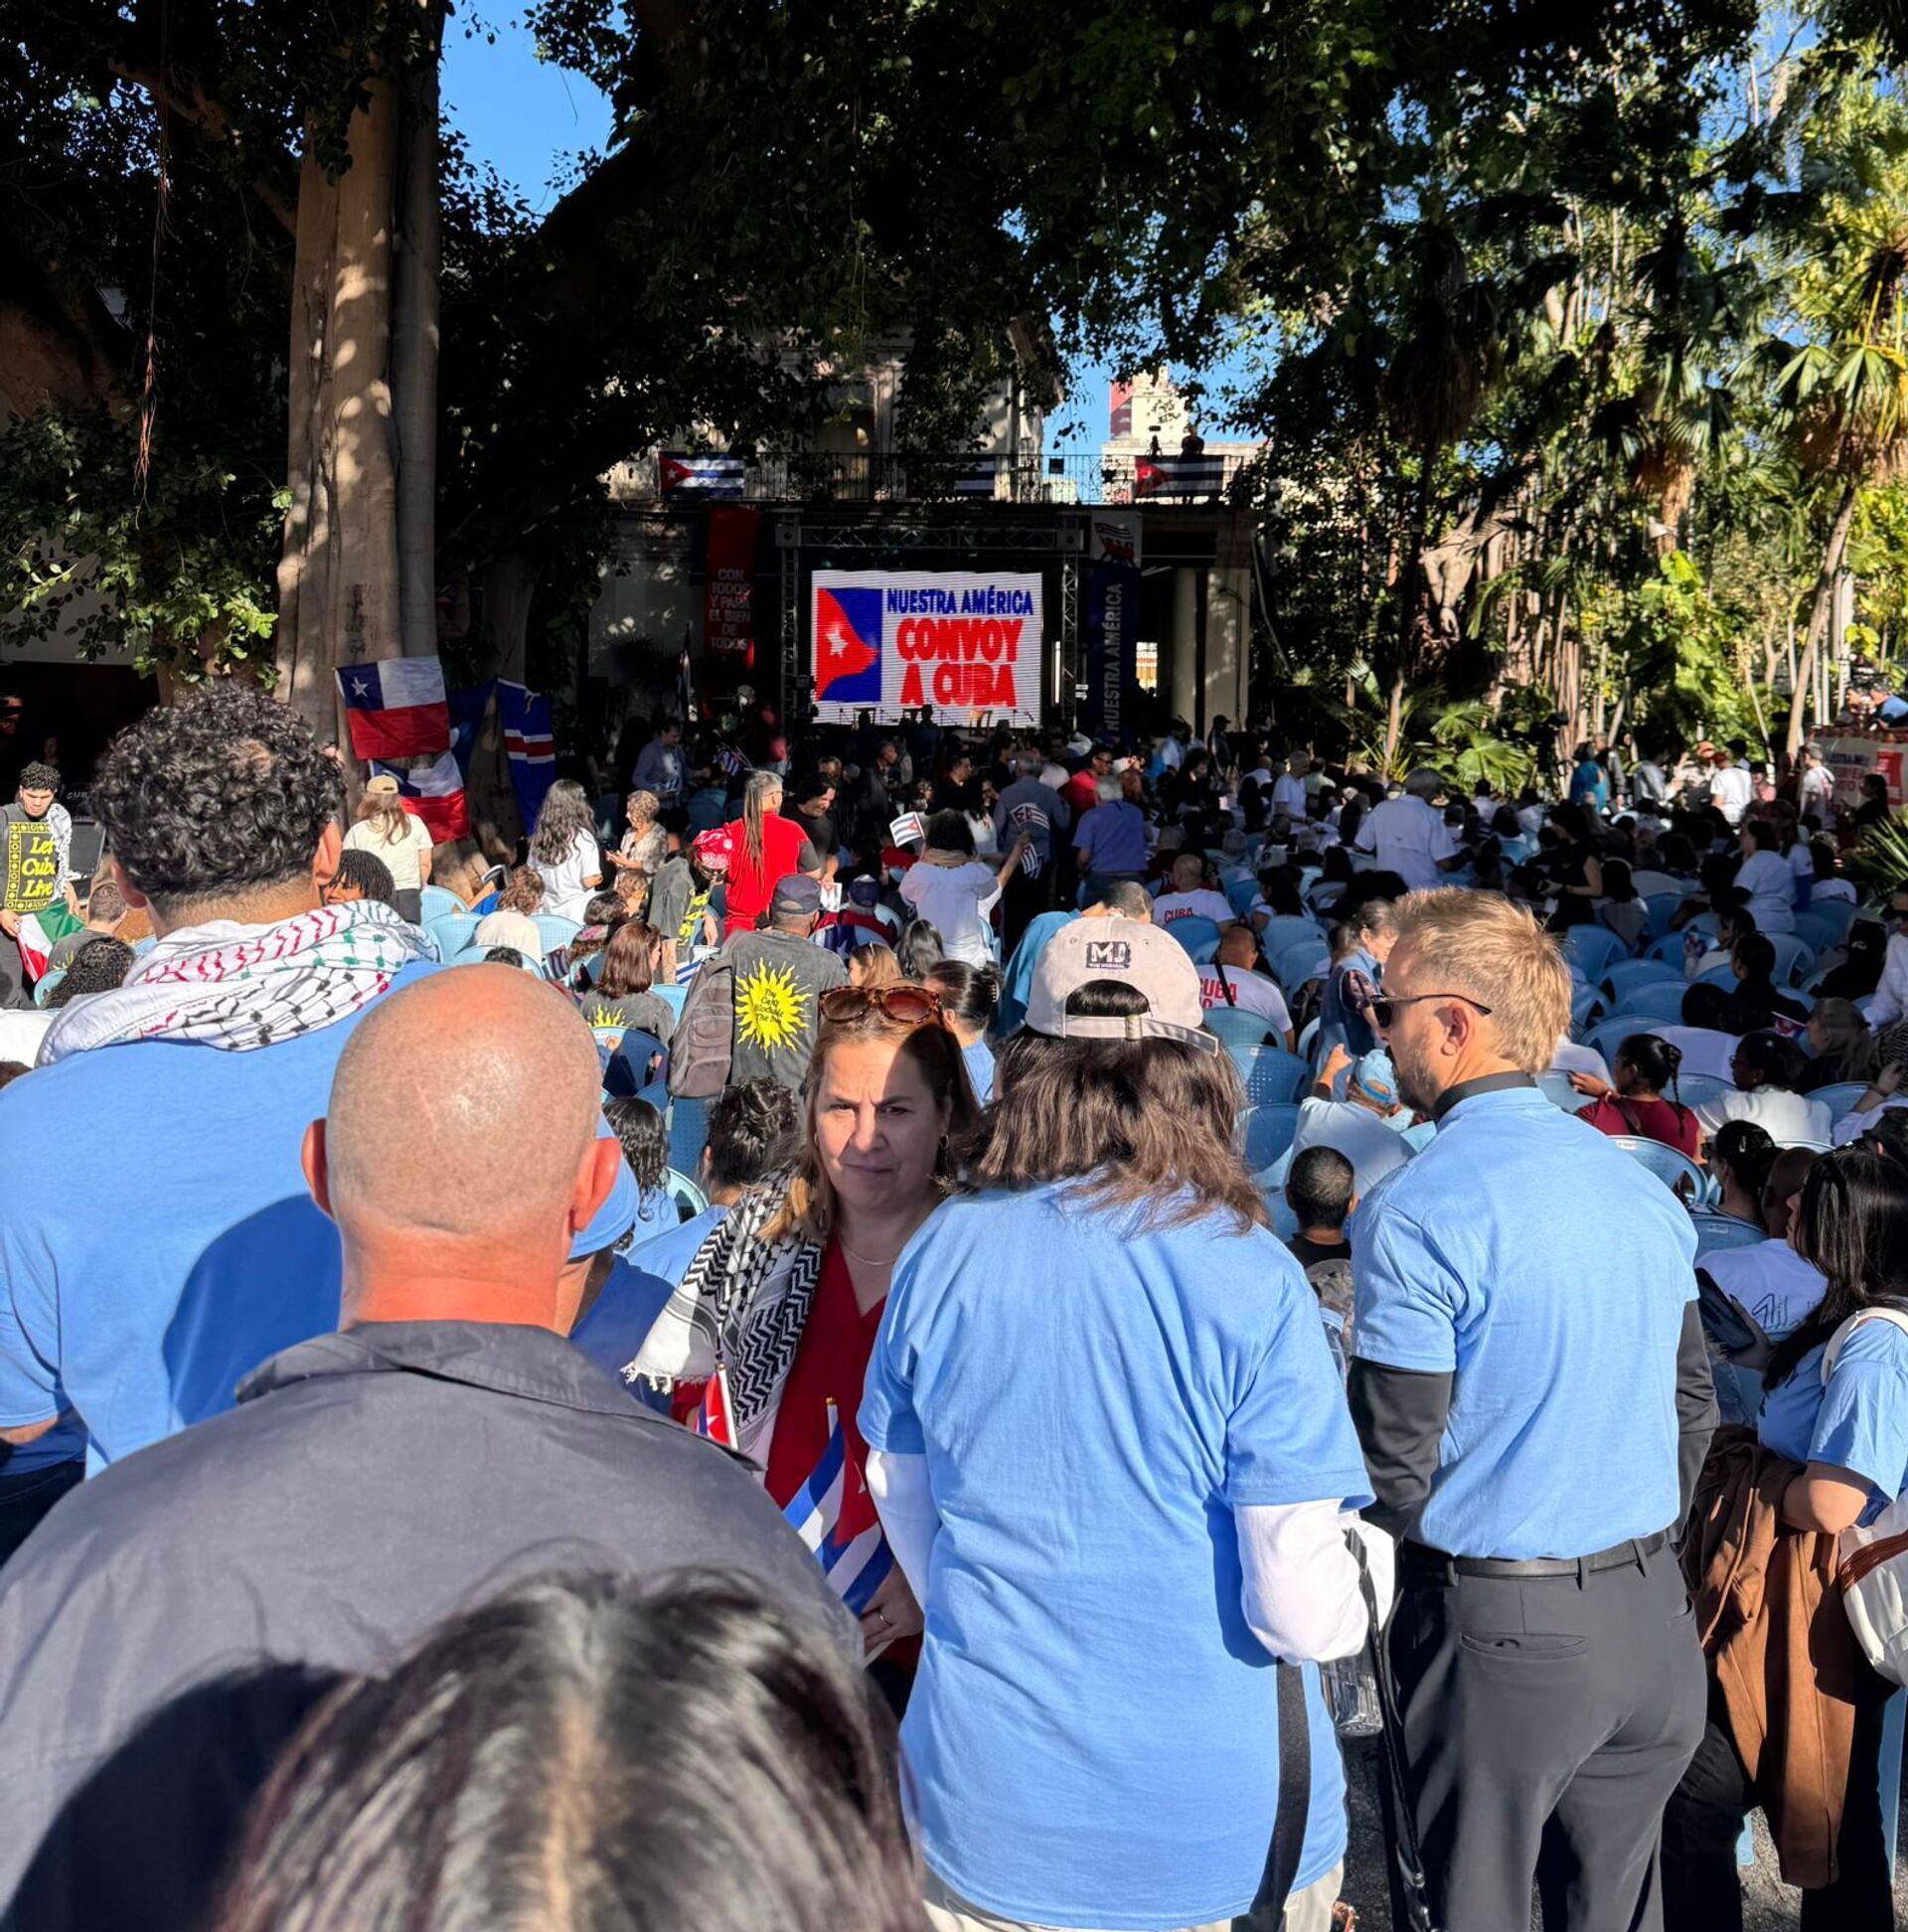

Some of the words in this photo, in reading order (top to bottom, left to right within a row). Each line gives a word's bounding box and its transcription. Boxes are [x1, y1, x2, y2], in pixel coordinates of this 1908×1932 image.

[717, 568, 745, 581] CON
[712, 581, 751, 594] TODOS
[711, 595, 717, 607] Y
[887, 587, 957, 614] NUESTRA
[961, 584, 1034, 615] AMÉRICA
[709, 609, 722, 621] EL
[724, 610, 751, 623] BIEN
[1101, 582, 1123, 658] AMÉRICA
[721, 623, 737, 636] DE
[711, 637, 748, 650] TODOS
[896, 618, 1024, 663] CONVOY
[900, 663, 925, 707] A
[932, 663, 1017, 707] CUBA
[1103, 661, 1121, 731] NUESTRA
[30, 836, 55, 855] Let
[22, 879, 54, 897] Live
[1164, 907, 1193, 923] CUBA
[1199, 978, 1237, 1002] UBA
